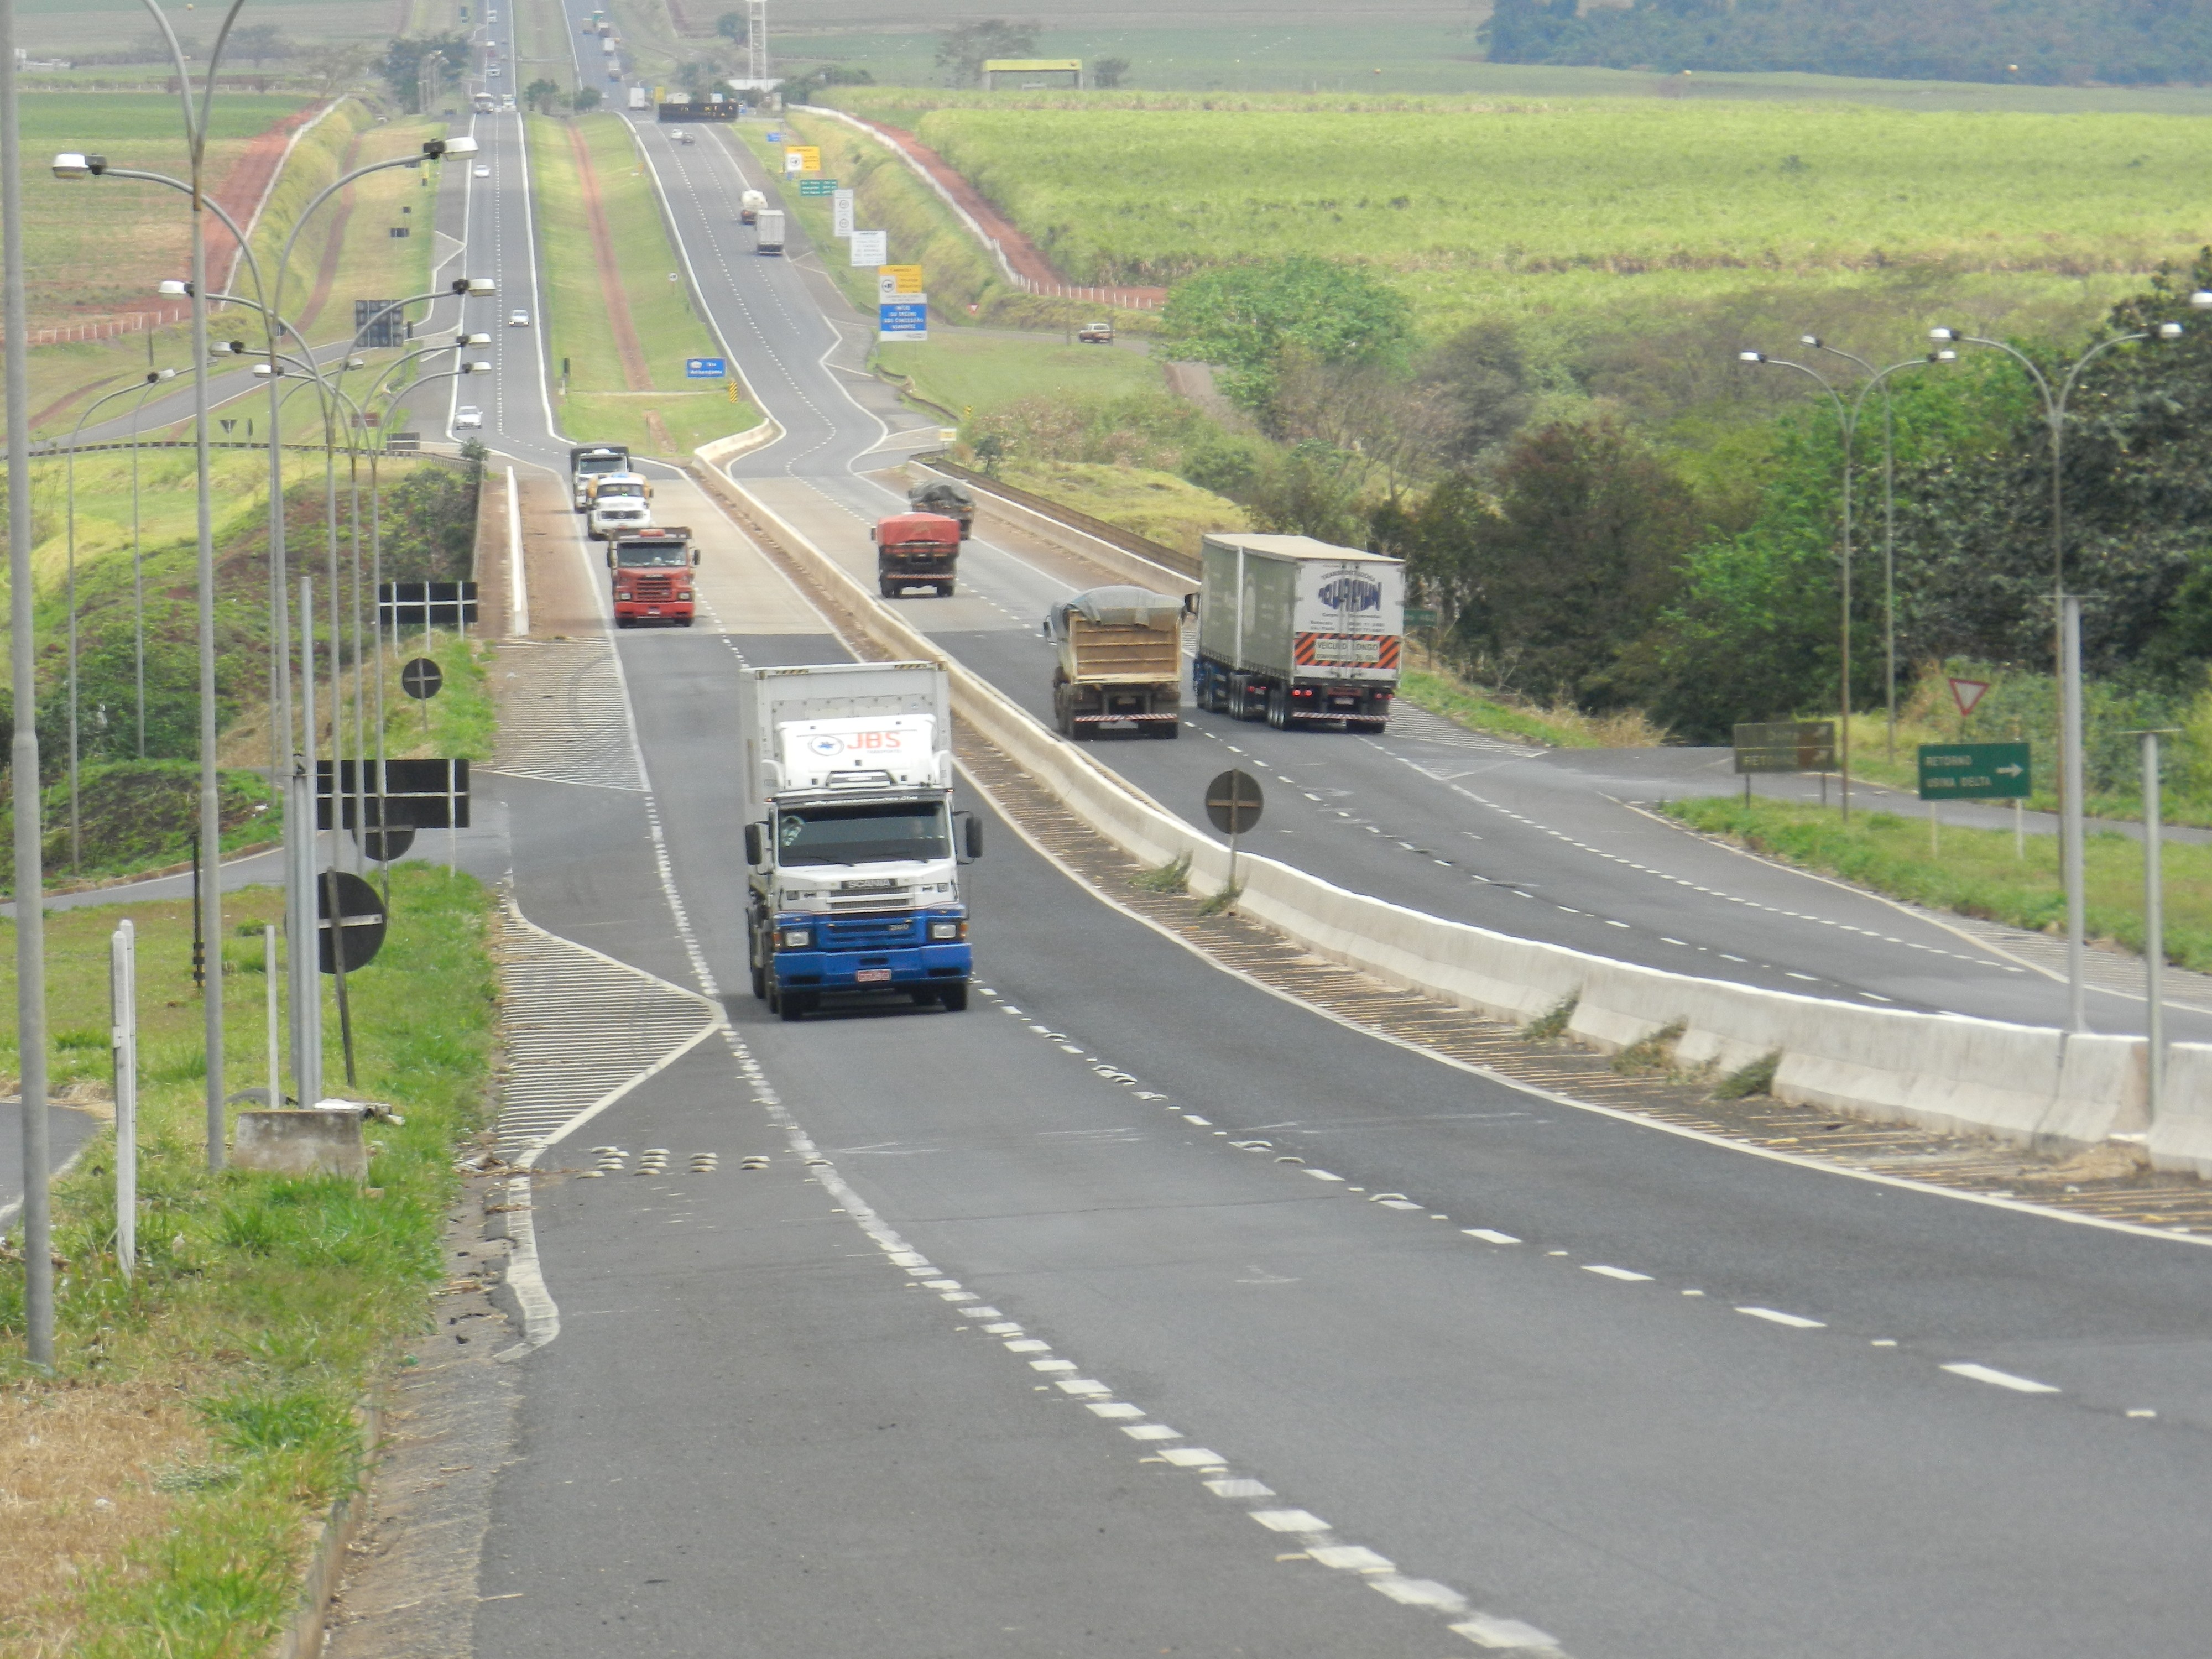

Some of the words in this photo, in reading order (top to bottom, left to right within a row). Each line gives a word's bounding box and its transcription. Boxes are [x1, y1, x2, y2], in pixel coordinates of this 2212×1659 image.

[847, 732, 901, 749] JBS
[1926, 755, 1973, 766] RETORNO
[1961, 776, 1992, 787] DELTA
[848, 878, 891, 888] SCANIA
